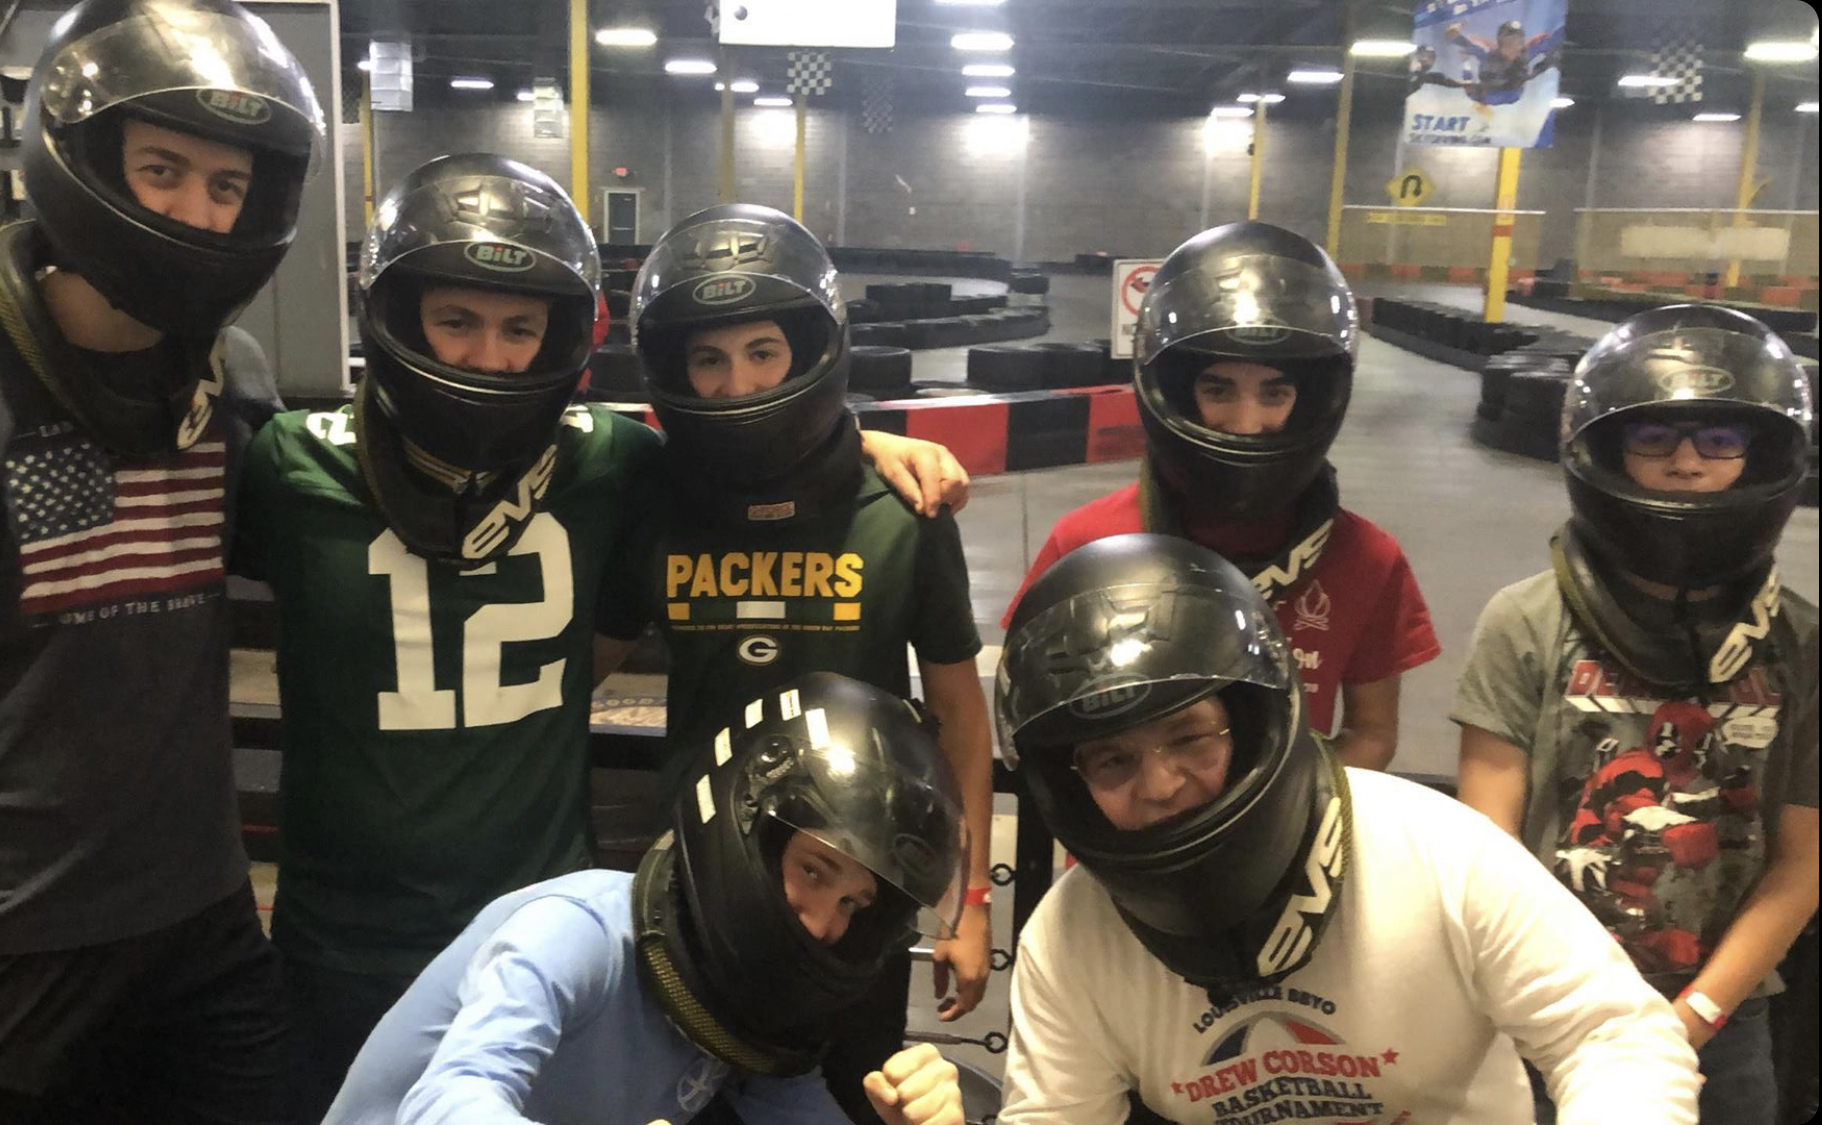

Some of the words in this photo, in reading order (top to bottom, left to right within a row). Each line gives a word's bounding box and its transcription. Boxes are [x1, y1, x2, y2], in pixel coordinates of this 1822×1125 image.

[1412, 114, 1471, 132] START
[667, 552, 864, 598] PACKERS
[99, 604, 119, 619] OF
[124, 601, 161, 615] THE
[368, 512, 574, 730] 12
[738, 635, 780, 664] G
[1185, 1058, 1258, 1103] DREW
[1262, 1050, 1382, 1078] CORSON
[1211, 1076, 1373, 1118] BASKETBALL
